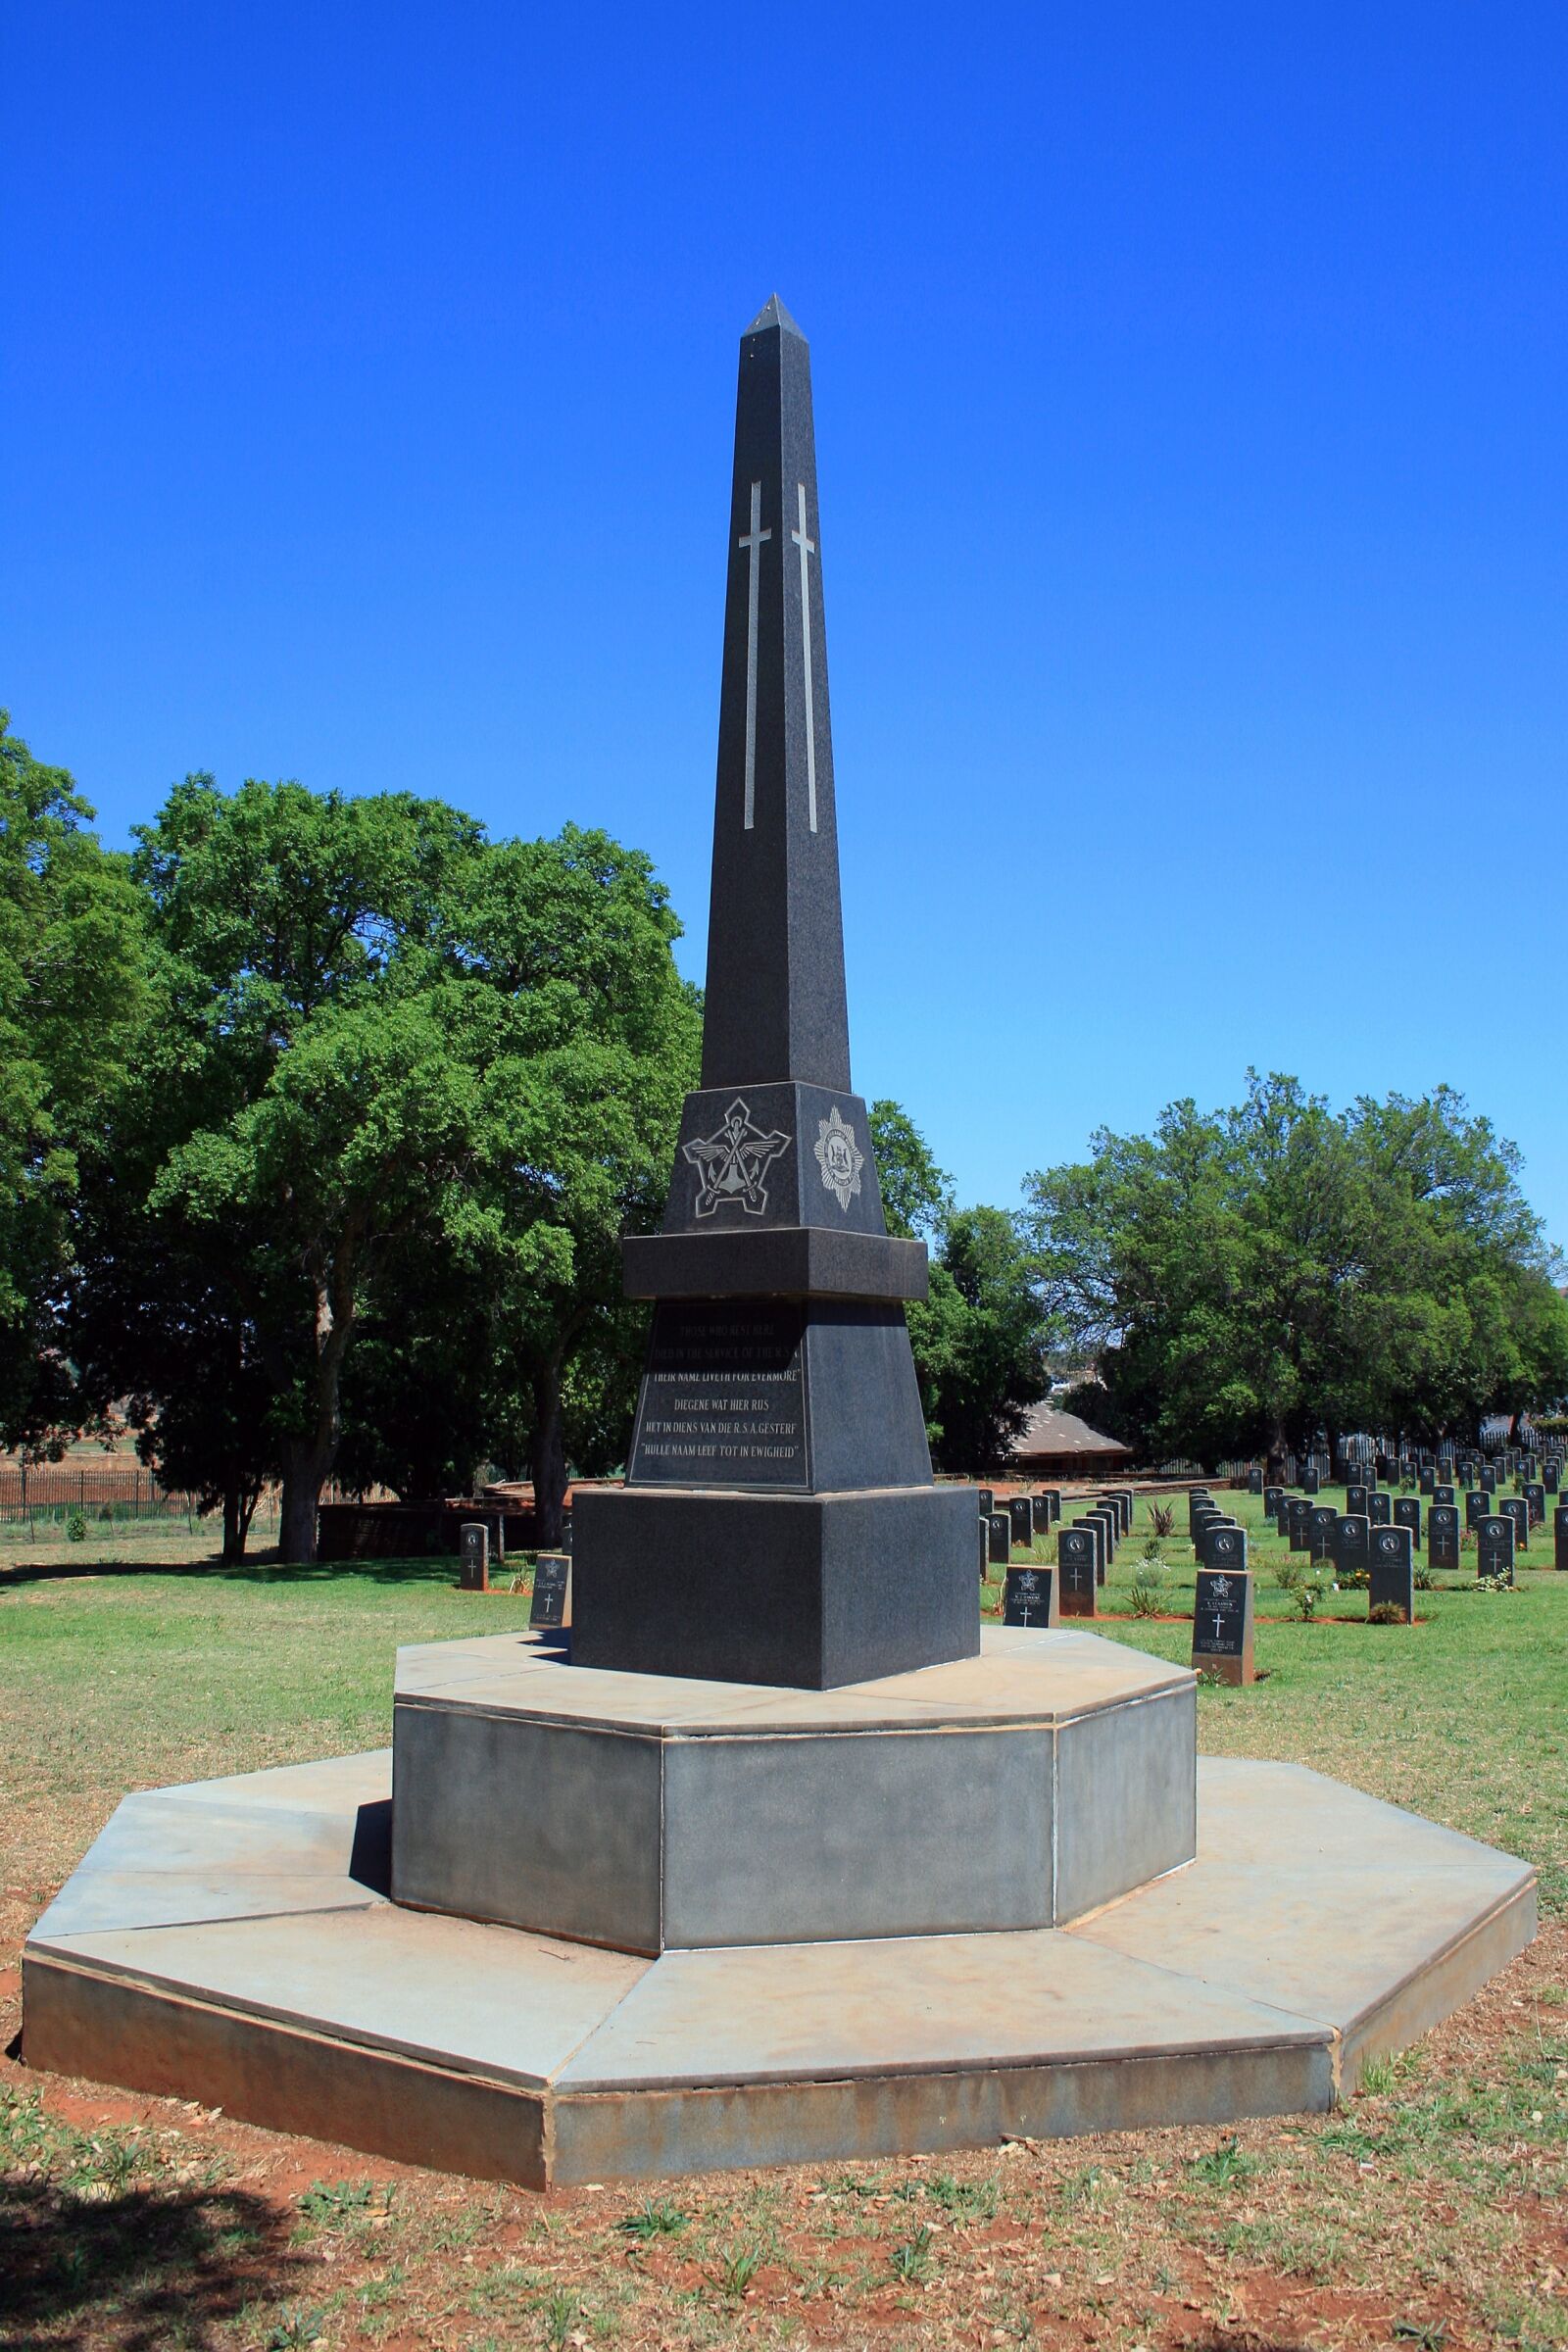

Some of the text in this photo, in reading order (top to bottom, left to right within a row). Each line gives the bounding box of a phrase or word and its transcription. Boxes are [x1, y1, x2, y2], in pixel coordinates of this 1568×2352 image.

[677, 1371, 700, 1382] NAME
[702, 1371, 730, 1382] LIVETH
[732, 1371, 750, 1382] FOR
[674, 1398, 769, 1411] DIEGENE WAT HIER RUS
[645, 1421, 662, 1433] HET
[662, 1421, 671, 1433] IN
[672, 1421, 698, 1434] DIENS
[700, 1422, 716, 1434] VAN
[717, 1422, 731, 1434] DIE
[758, 1422, 797, 1435] GESTERF
[671, 1444, 696, 1456] NAAM
[697, 1445, 717, 1456] LEEF
[719, 1446, 738, 1457] TOT
[740, 1446, 749, 1457] IN
